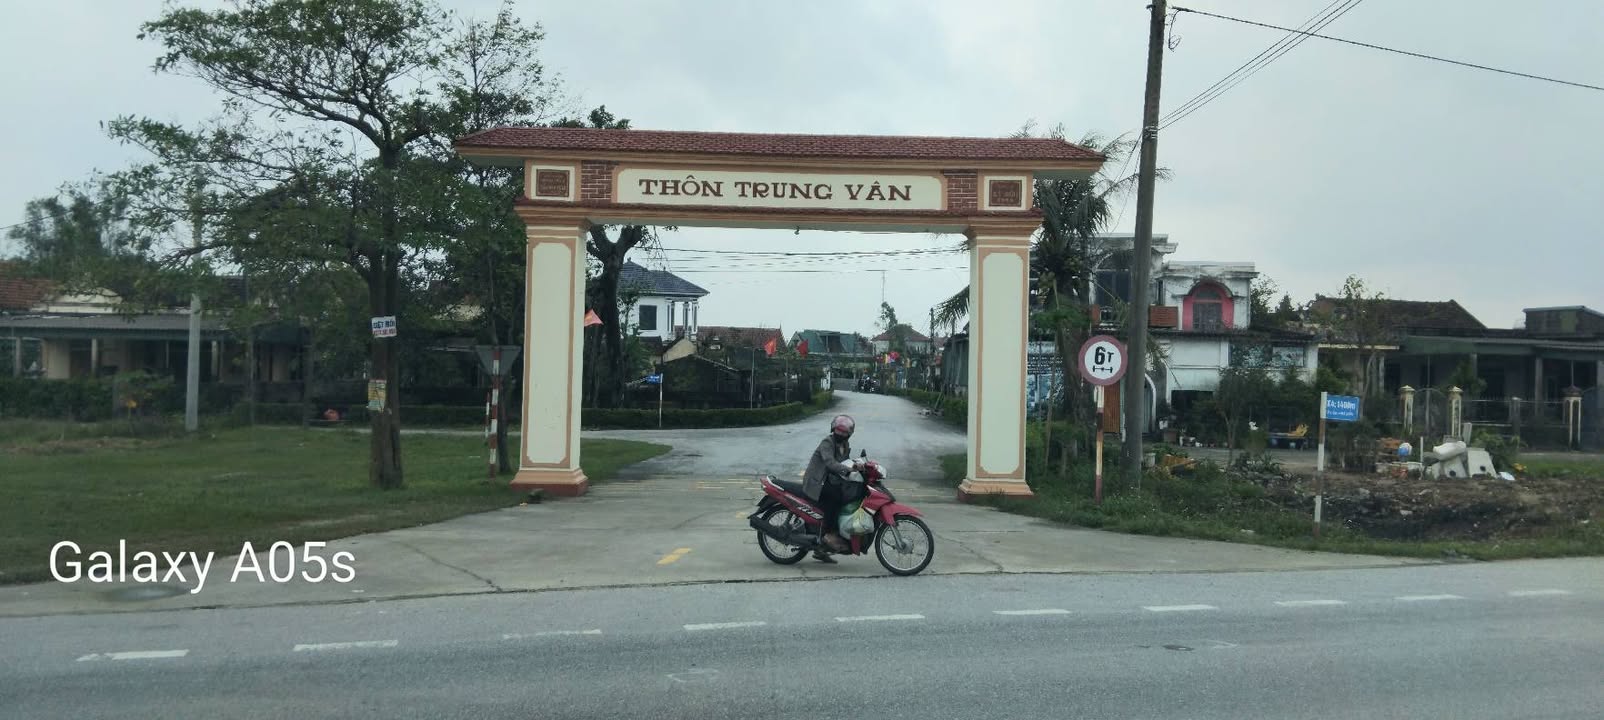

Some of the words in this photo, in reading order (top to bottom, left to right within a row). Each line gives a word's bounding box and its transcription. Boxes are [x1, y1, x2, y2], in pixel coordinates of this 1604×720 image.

[639, 175, 723, 197] THÔN
[735, 181, 832, 200] TRUNG
[844, 181, 912, 201] VÂN
